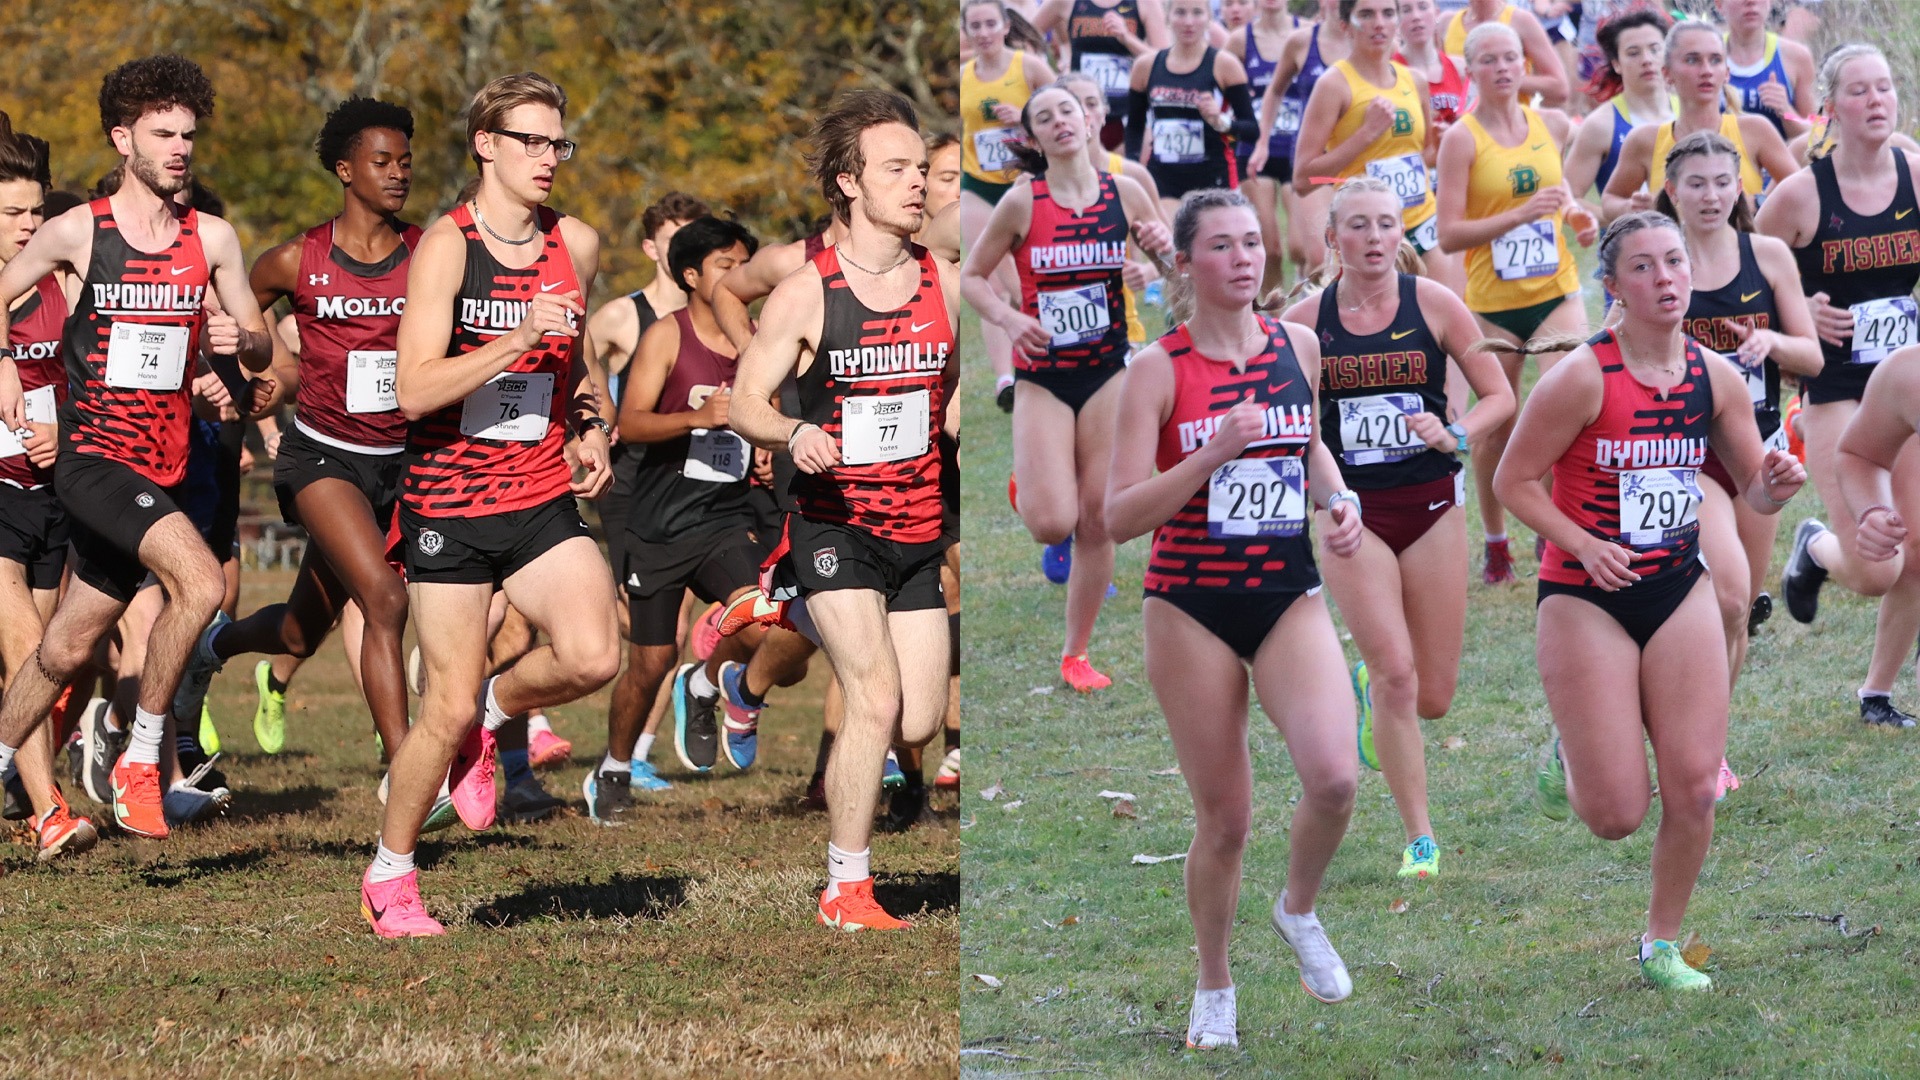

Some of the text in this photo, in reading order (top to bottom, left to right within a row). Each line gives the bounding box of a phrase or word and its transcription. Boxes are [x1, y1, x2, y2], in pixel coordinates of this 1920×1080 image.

[984, 142, 1008, 162] 28
[1163, 131, 1195, 154] 437
[1512, 166, 1539, 198] B
[1506, 237, 1545, 267] 273
[315, 296, 407, 319] MOLLO
[1052, 303, 1098, 335] 300
[1864, 314, 1909, 348] 423
[11, 341, 60, 360] LOY
[141, 353, 158, 370] 74
[382, 360, 397, 369] EC
[503, 380, 527, 392] ECC
[500, 402, 520, 420] 76
[880, 403, 902, 414] ECC
[879, 424, 898, 442] 77
[1356, 413, 1410, 448] 420
[712, 452, 731, 466] 118
[1227, 481, 1287, 520] 292
[1639, 489, 1691, 530] 297
